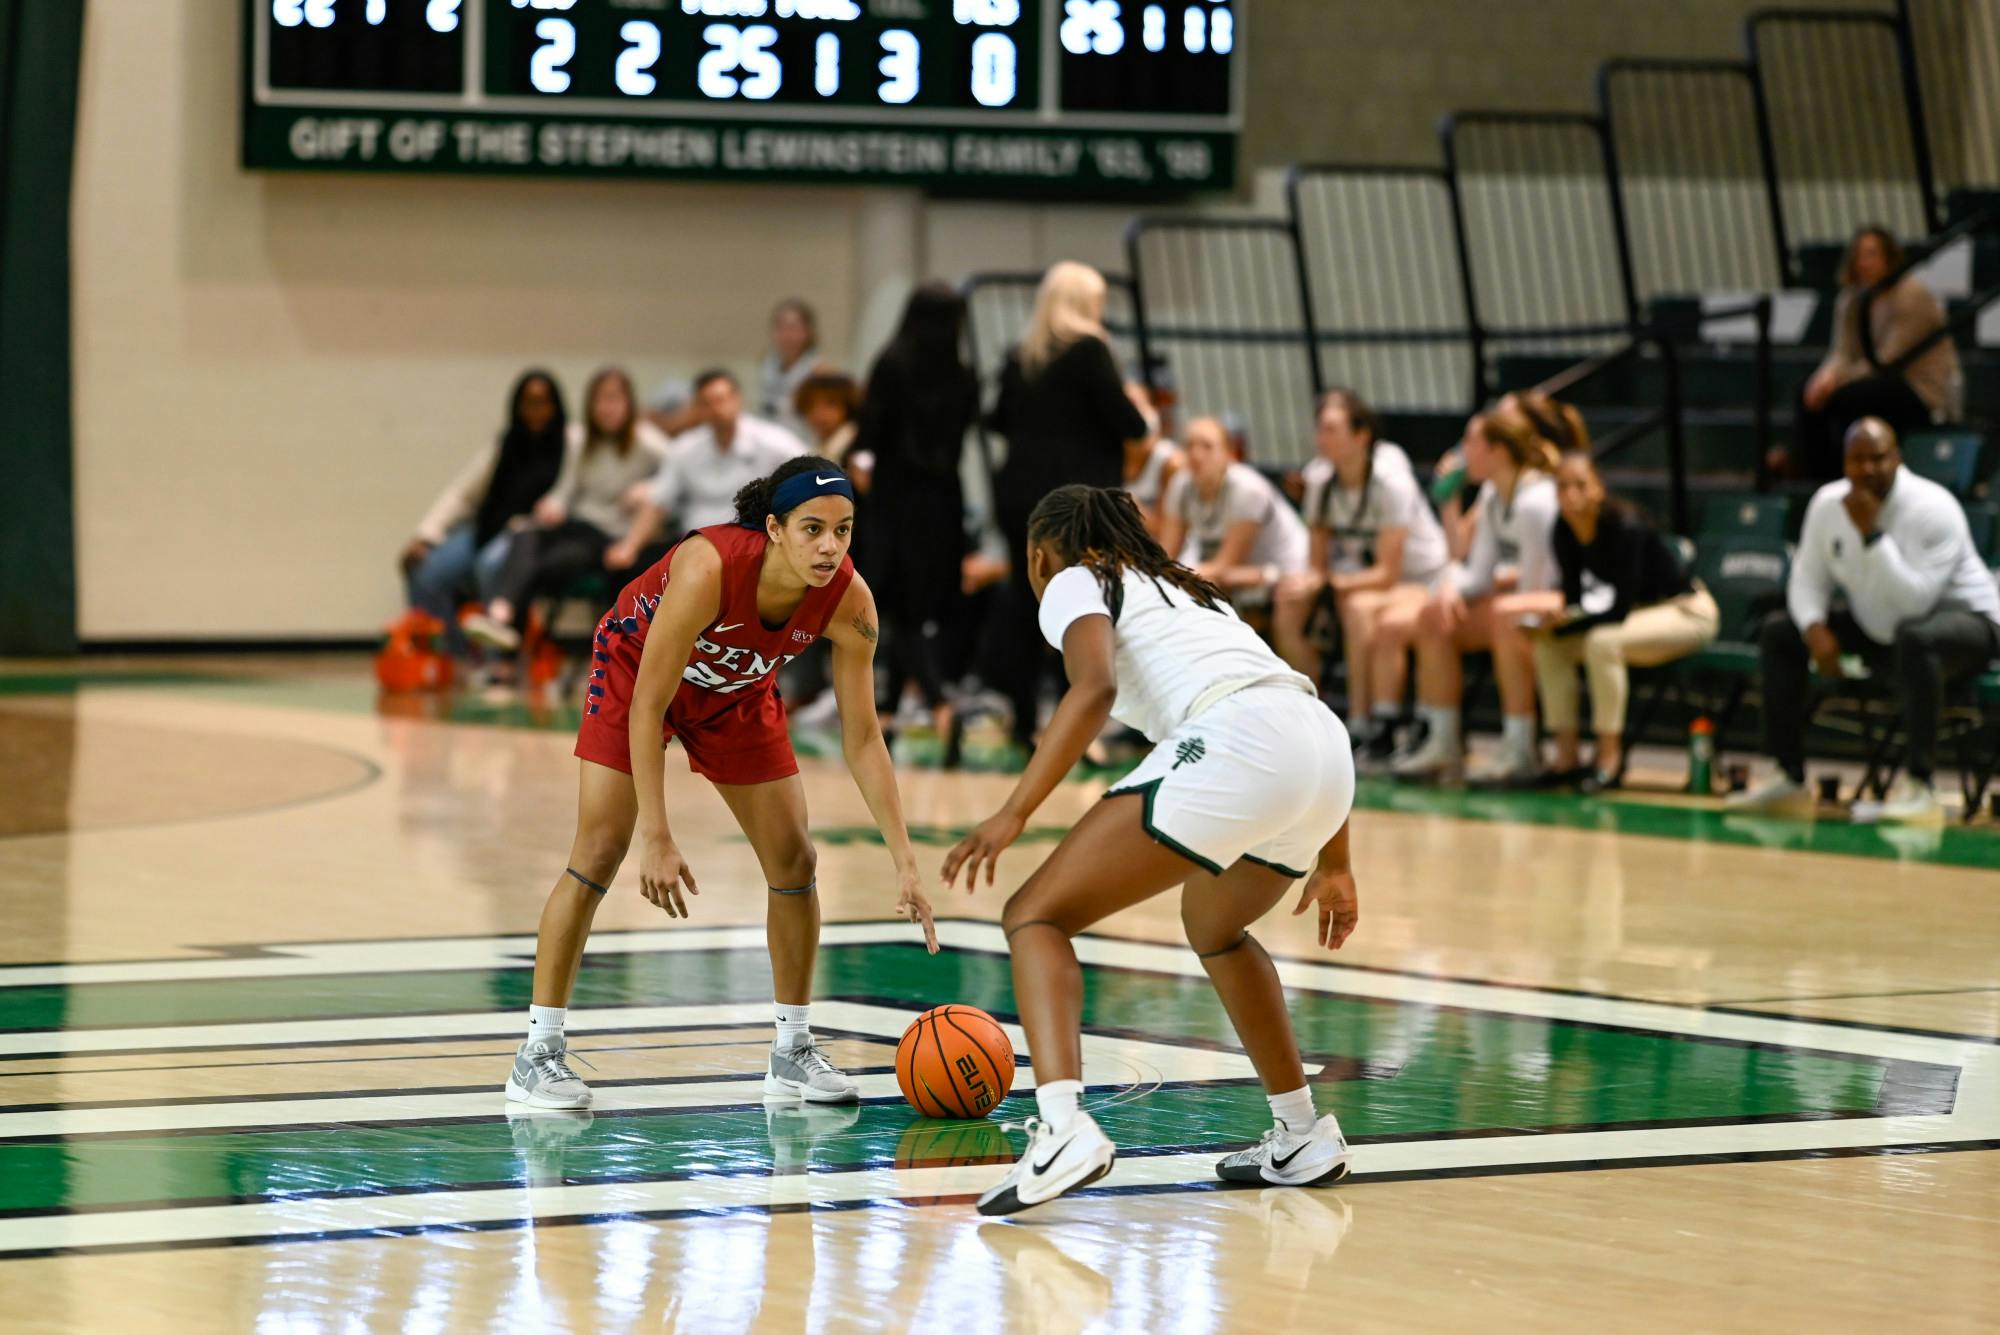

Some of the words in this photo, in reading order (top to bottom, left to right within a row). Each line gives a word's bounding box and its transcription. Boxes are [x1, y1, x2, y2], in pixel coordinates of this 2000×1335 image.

[530, 18, 576, 94] 2
[615, 20, 661, 96] 2
[697, 24, 782, 100] 25
[814, 31, 840, 97] 1
[877, 29, 920, 104] 3
[970, 32, 1017, 107] 0
[289, 117, 383, 161] GIFT
[389, 119, 446, 162] OF
[453, 121, 532, 164] THE
[539, 123, 716, 167] STEPHEN
[722, 128, 950, 173] LEWINSTEIN
[953, 134, 1083, 177] FAMILY
[955, 1053, 992, 1112] ELITE
